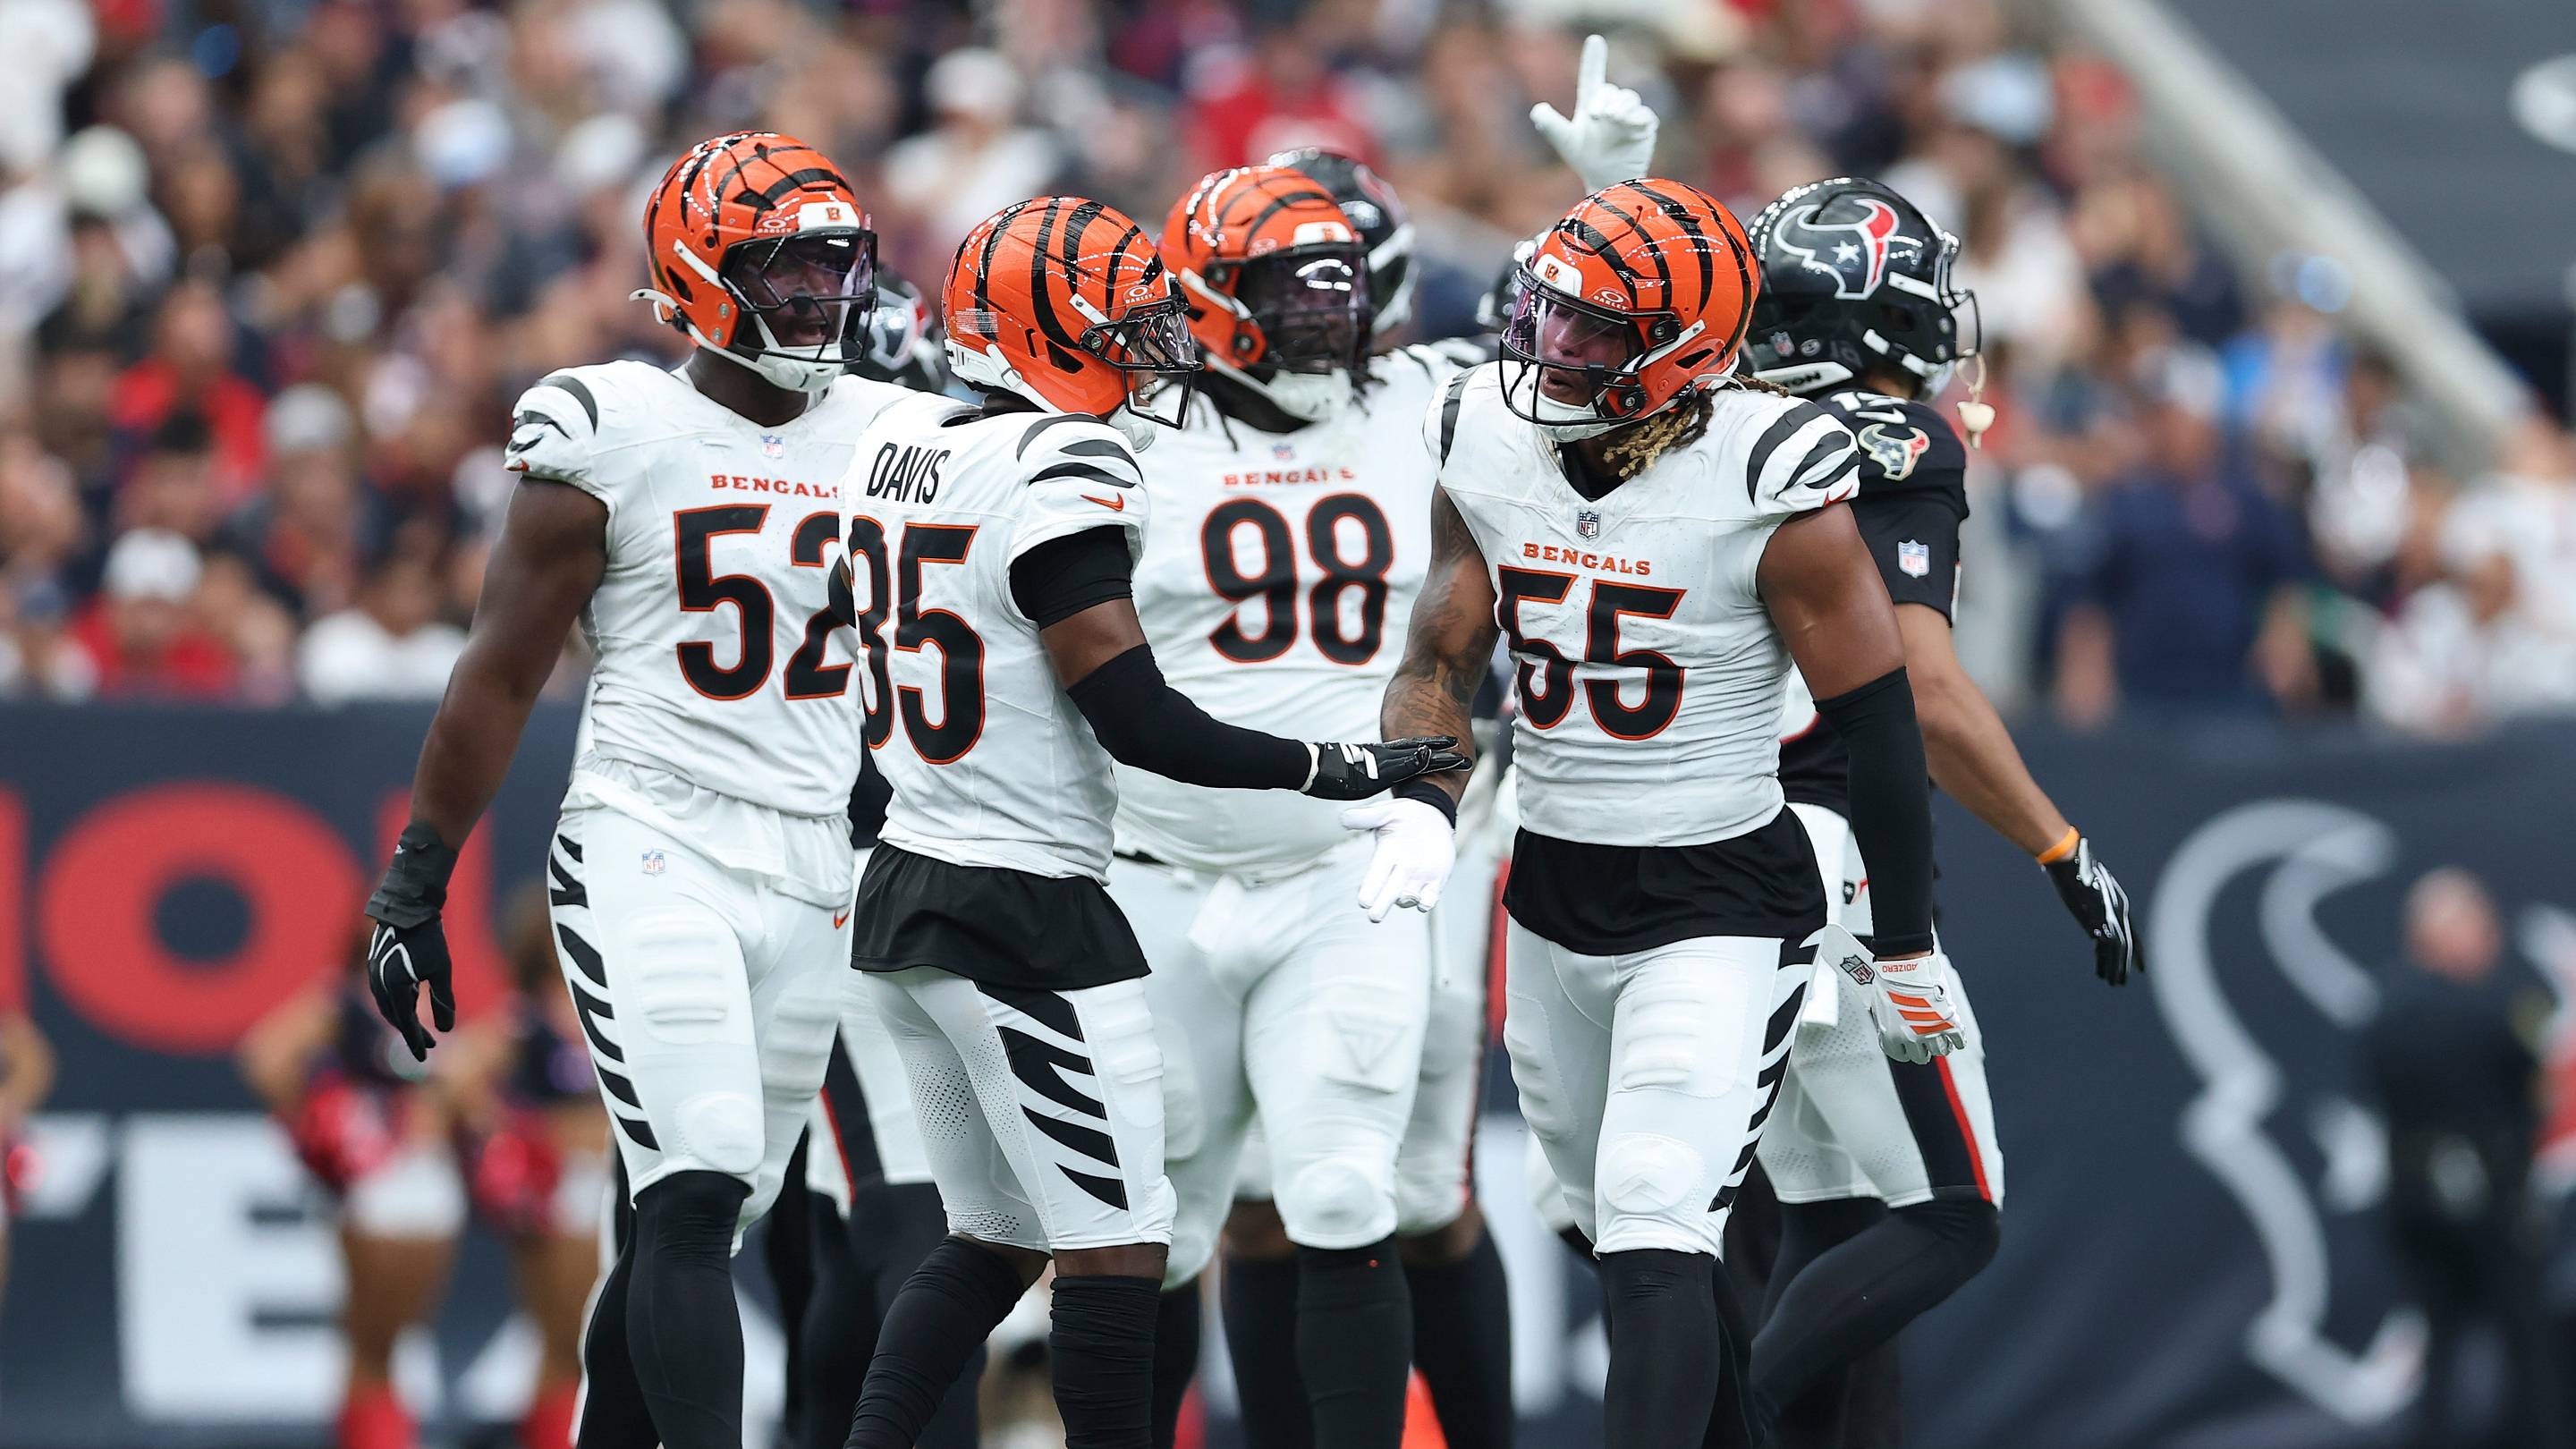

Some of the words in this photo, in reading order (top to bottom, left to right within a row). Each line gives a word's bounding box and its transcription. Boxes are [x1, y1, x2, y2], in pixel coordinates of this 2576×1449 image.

[1592, 294, 1630, 310] OAKLEY
[866, 441, 952, 504] DAVIS
[1200, 492, 1394, 665] 98
[1523, 542, 1651, 576] BENGALS
[674, 503, 854, 701] 52
[1497, 564, 1689, 741] 55
[1881, 962, 1919, 973] ADIZERO
